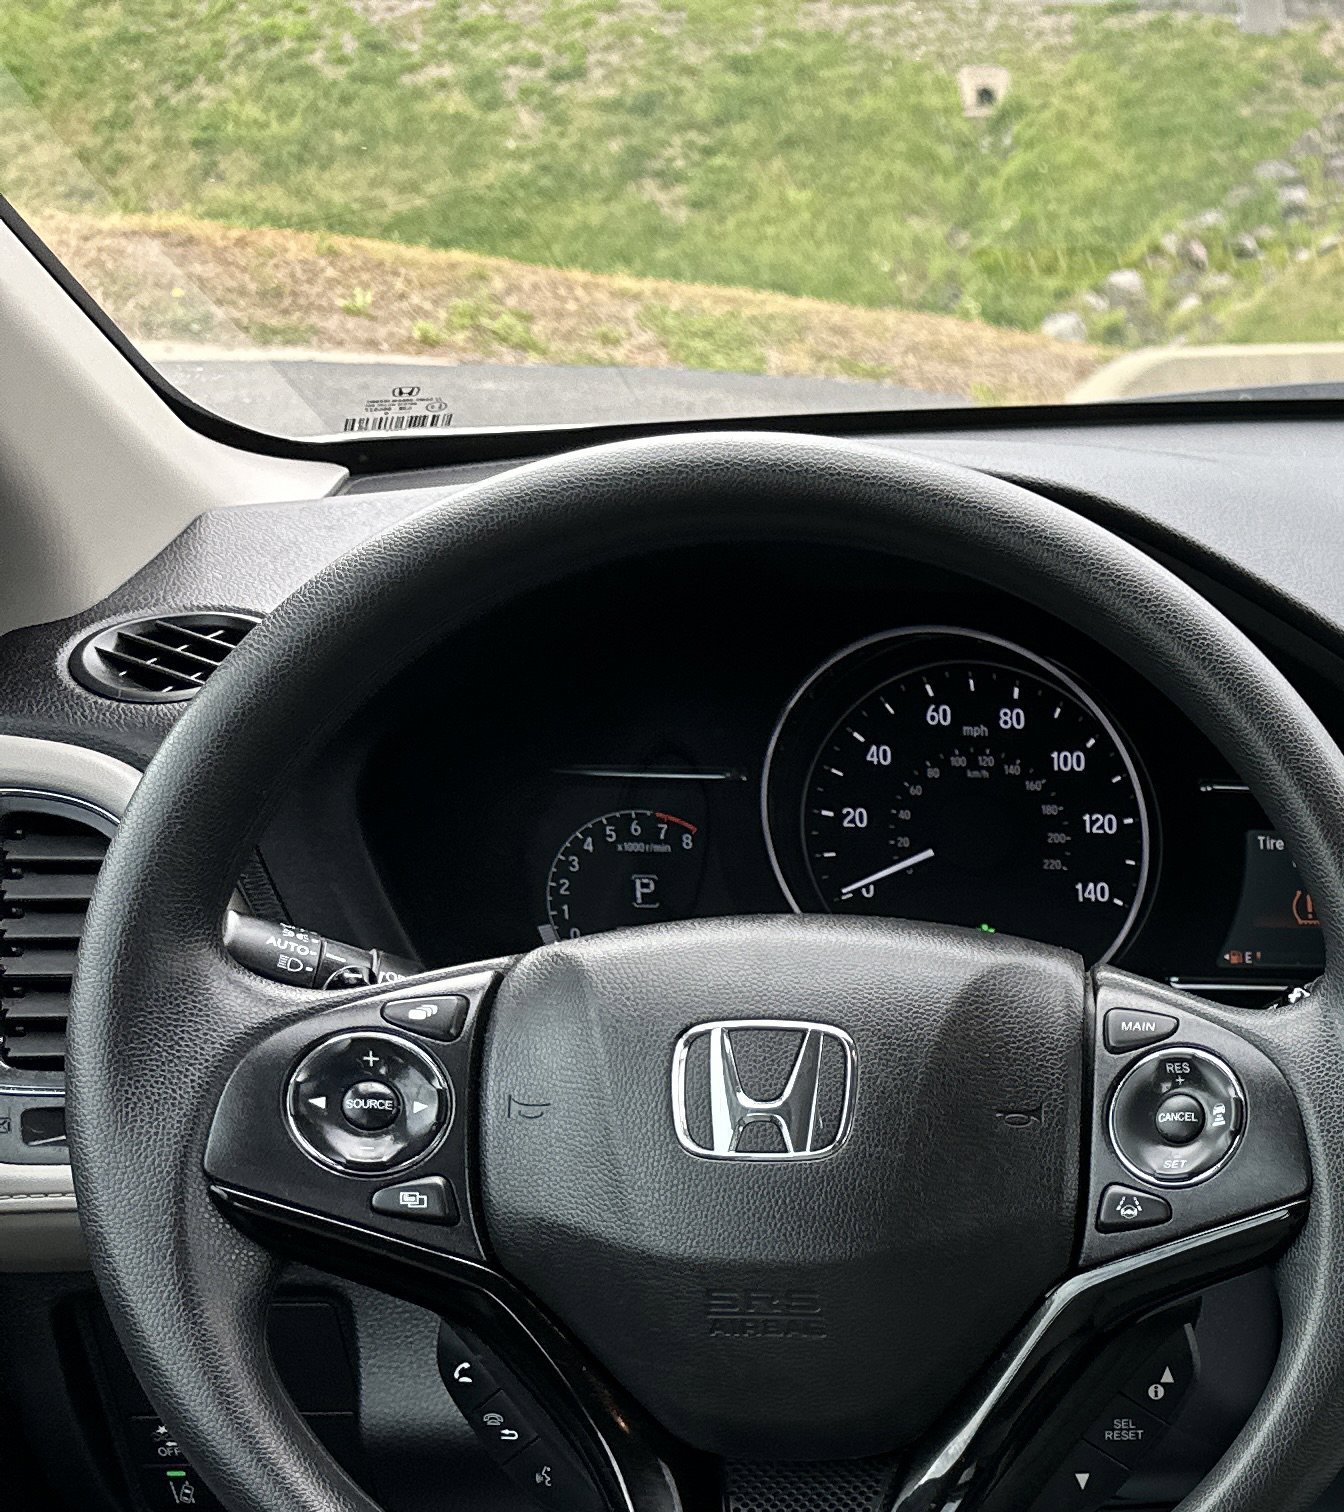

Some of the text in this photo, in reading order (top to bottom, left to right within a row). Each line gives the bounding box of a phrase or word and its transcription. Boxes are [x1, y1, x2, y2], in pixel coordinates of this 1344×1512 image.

[926, 704, 951, 726] 60
[999, 708, 1025, 730] 80
[962, 725, 988, 738] mph
[866, 745, 892, 765] 40
[950, 756, 995, 767] 100 120
[1050, 751, 1086, 772] 100
[927, 767, 940, 778] 80
[966, 768, 989, 779] km/h
[1004, 765, 1021, 776] 140
[909, 785, 923, 796] 60
[1025, 780, 1042, 792] 160
[1041, 804, 1058, 815] 180
[842, 807, 868, 828] 20
[1082, 814, 1117, 834] 120
[605, 826, 617, 842] 5
[630, 820, 641, 836] 6
[657, 823, 668, 840] 7
[583, 836, 594, 853] 4
[682, 833, 693, 850] 8
[1047, 833, 1066, 844] 200
[1257, 835, 1285, 851] Tire
[568, 856, 580, 872] 3
[1043, 859, 1062, 870] 220
[559, 879, 570, 895] 2
[634, 877, 656, 904] P
[1075, 882, 1109, 902] 140
[562, 904, 569, 920] 1
[266, 935, 310, 956] AUTO
[1121, 1021, 1156, 1033] MAIN
[1165, 1061, 1191, 1075] RES
[345, 1098, 393, 1111] SOURCE
[1157, 1110, 1199, 1124] CANCEL
[1163, 1158, 1187, 1170] SET
[1113, 1418, 1136, 1430] SEL
[1105, 1430, 1144, 1441] RESET
[157, 1446, 181, 1457] OFF
